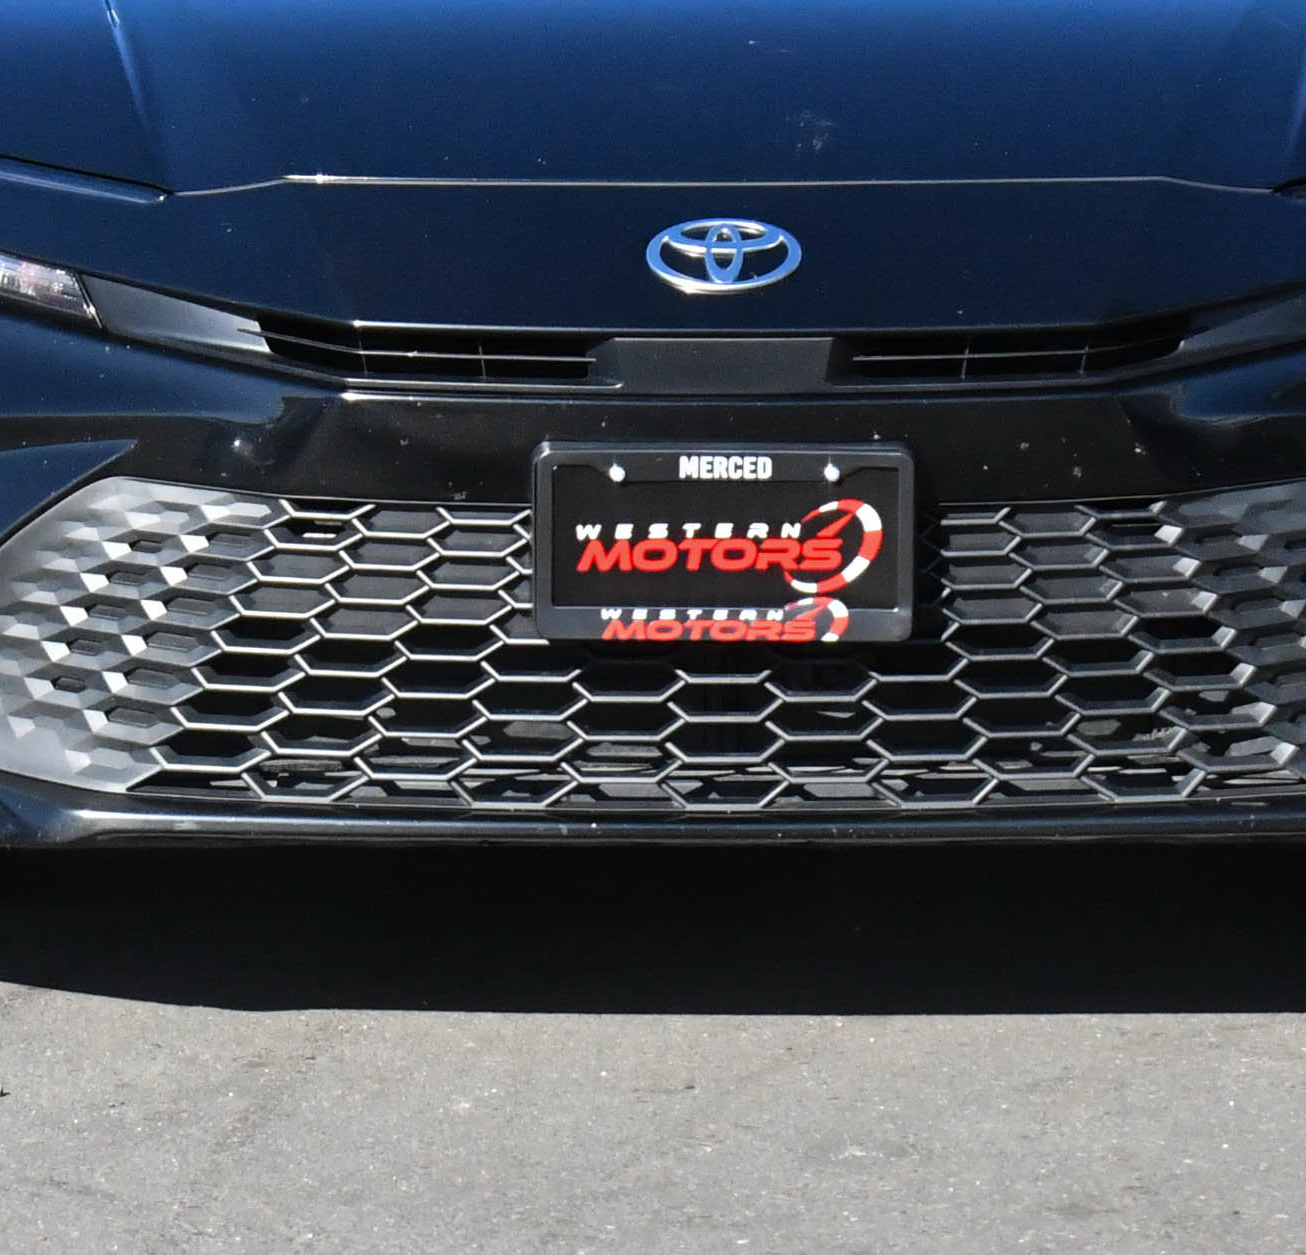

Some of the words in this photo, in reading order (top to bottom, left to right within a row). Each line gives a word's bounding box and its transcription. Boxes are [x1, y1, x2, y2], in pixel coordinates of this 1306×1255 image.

[679, 455, 773, 480] MERCED
[575, 522, 802, 541] WESTERN
[577, 539, 844, 573] MOTORS
[600, 607, 785, 621] WESTERN
[601, 620, 818, 643] MOTORS
